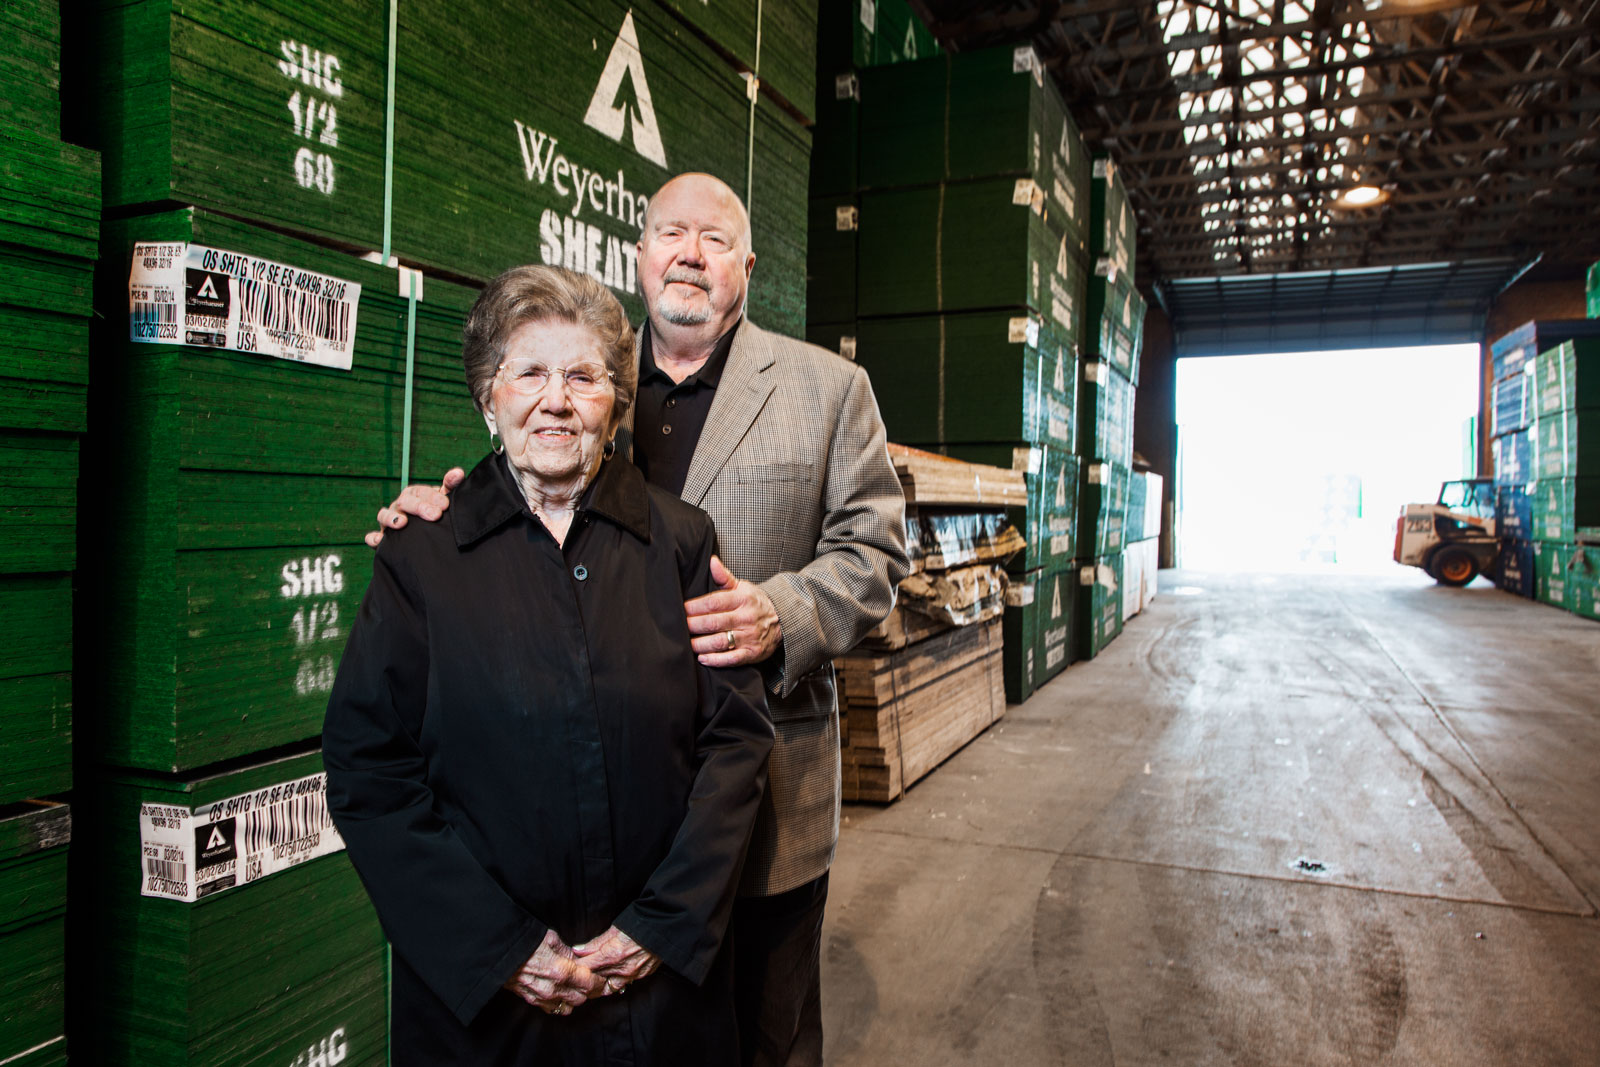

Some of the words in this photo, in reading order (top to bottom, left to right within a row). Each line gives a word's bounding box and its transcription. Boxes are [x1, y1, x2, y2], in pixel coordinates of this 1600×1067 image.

[279, 40, 342, 97] SHG
[288, 90, 338, 147] 1/2
[294, 147, 335, 195] 68
[513, 119, 649, 230] Weyerha
[539, 208, 641, 295] SHEAT
[203, 249, 218, 270] OS
[220, 253, 248, 277] SHTG
[252, 260, 266, 280] 1/2
[267, 264, 280, 284] SE
[281, 267, 294, 288] ES
[295, 272, 322, 295] 48X96
[323, 279, 346, 300] 32/16
[185, 315, 226, 329] 03/02/2014
[237, 331, 258, 352] USA
[281, 554, 342, 597] SHG
[291, 601, 338, 644] 1/2
[209, 802, 224, 822] OS
[225, 794, 251, 818] SHTG
[254, 790, 268, 811] 1/2
[269, 786, 282, 804] SE
[282, 783, 295, 801] ES
[296, 776, 322, 798] 48X96
[272, 833, 321, 861] 102750722533
[194, 860, 236, 882] 03/02/2014
[246, 860, 263, 882] USA
